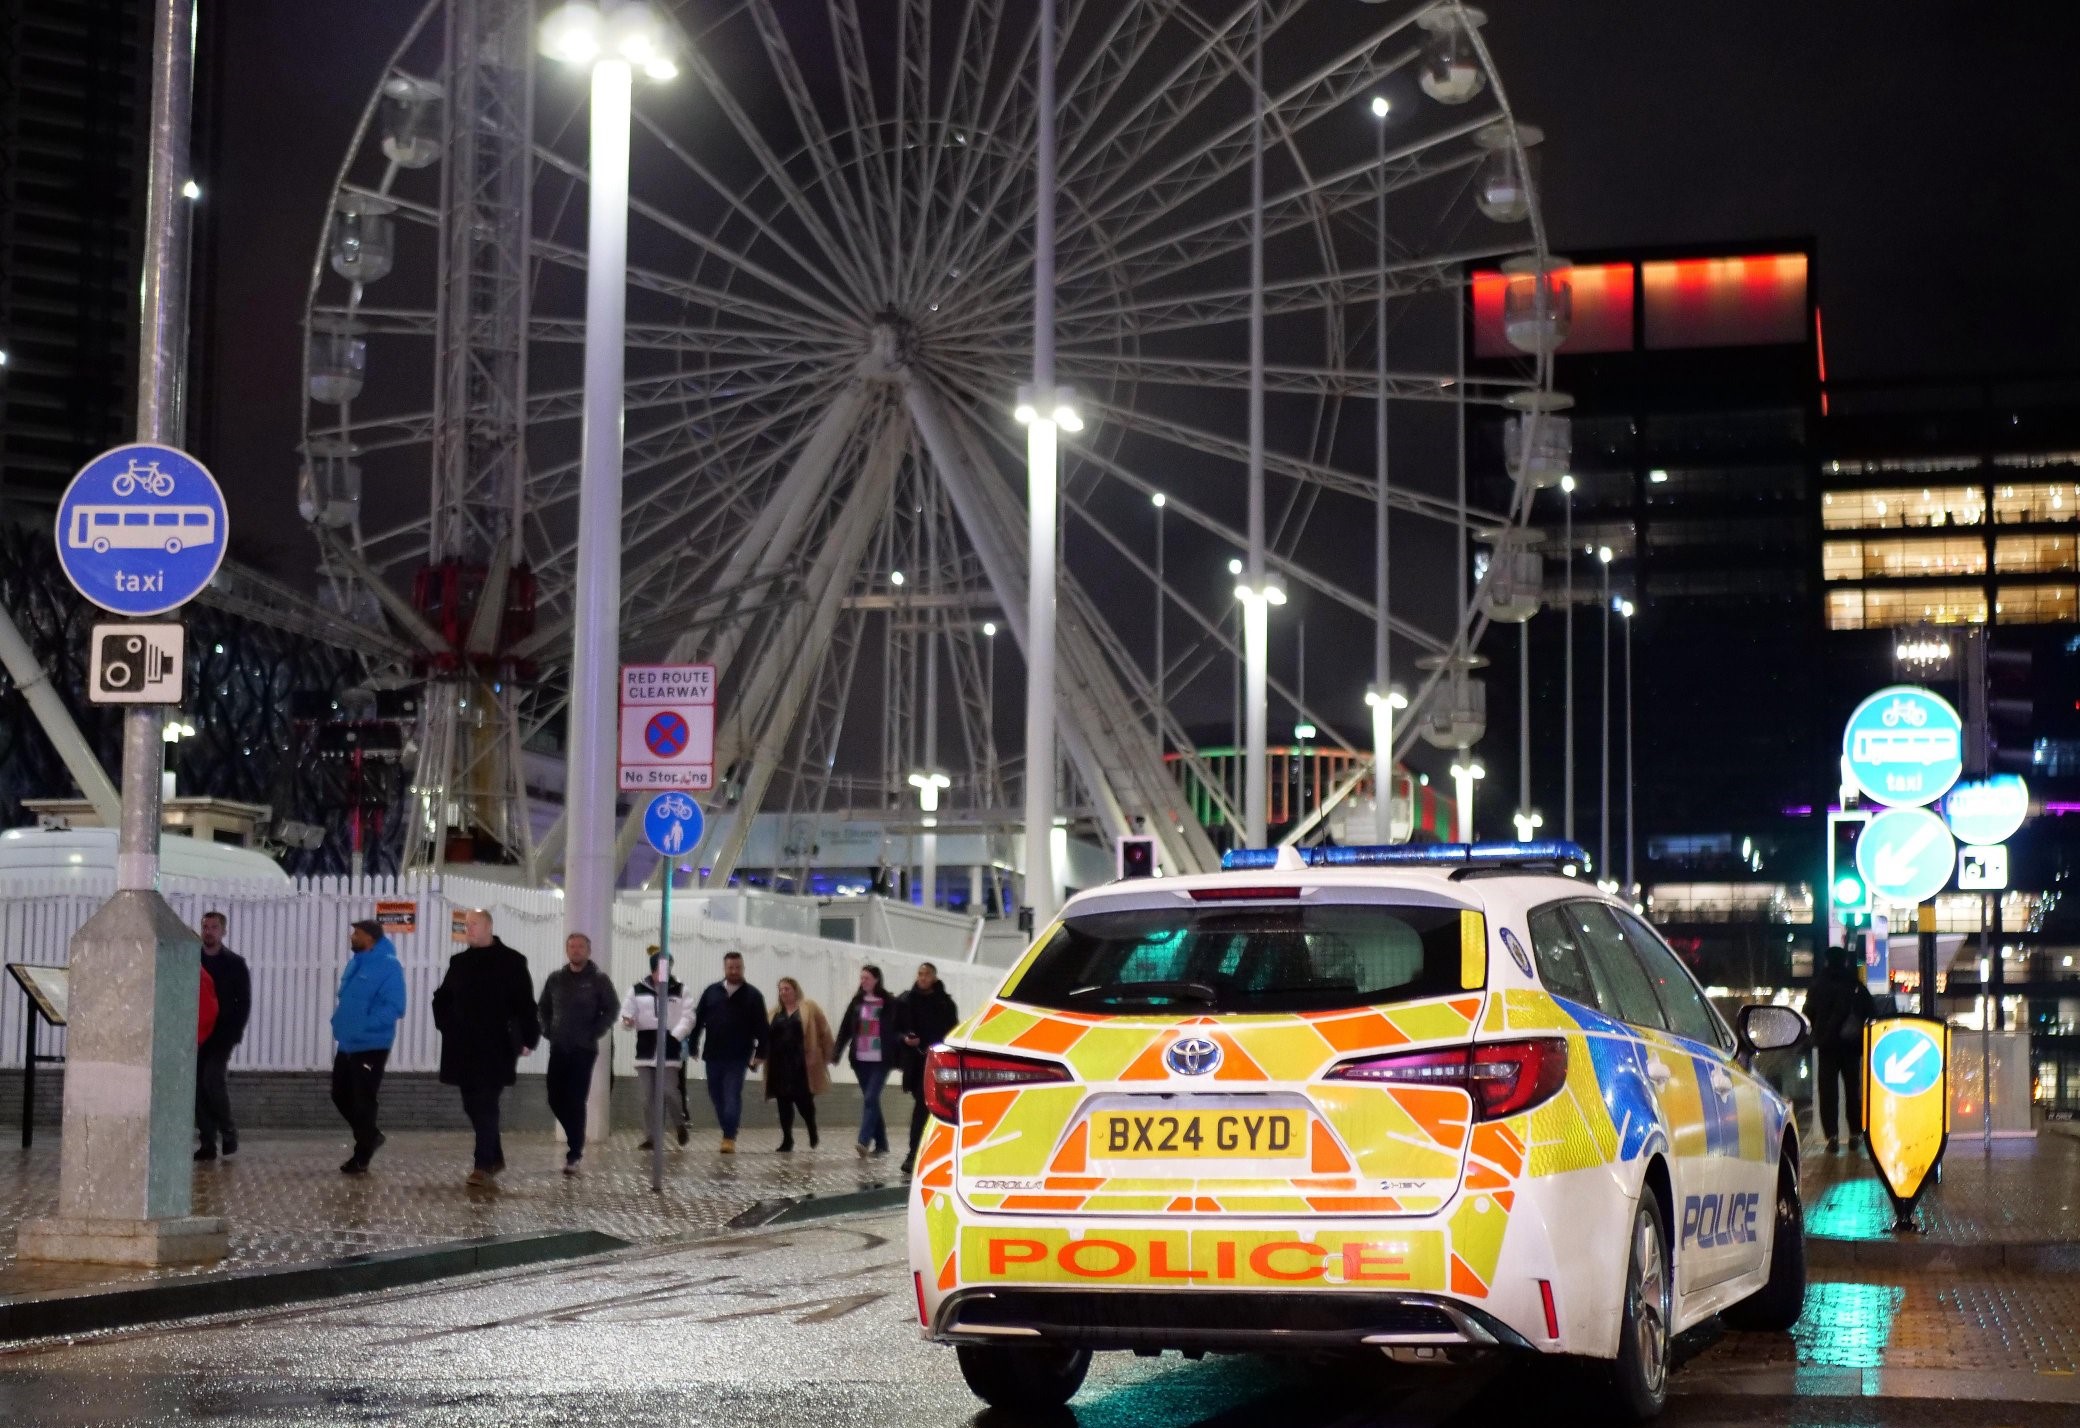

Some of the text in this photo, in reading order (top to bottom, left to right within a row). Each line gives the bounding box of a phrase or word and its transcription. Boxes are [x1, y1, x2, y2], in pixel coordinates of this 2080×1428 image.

[115, 570, 164, 592] taxi
[628, 671, 710, 684] RED ROUTE
[629, 686, 708, 698] CLEARWAY
[625, 771, 643, 783] No
[1108, 1115, 1291, 1152] BX24 GYD
[1680, 1192, 1759, 1252] POLICE
[988, 1238, 1411, 1281] POLICE
